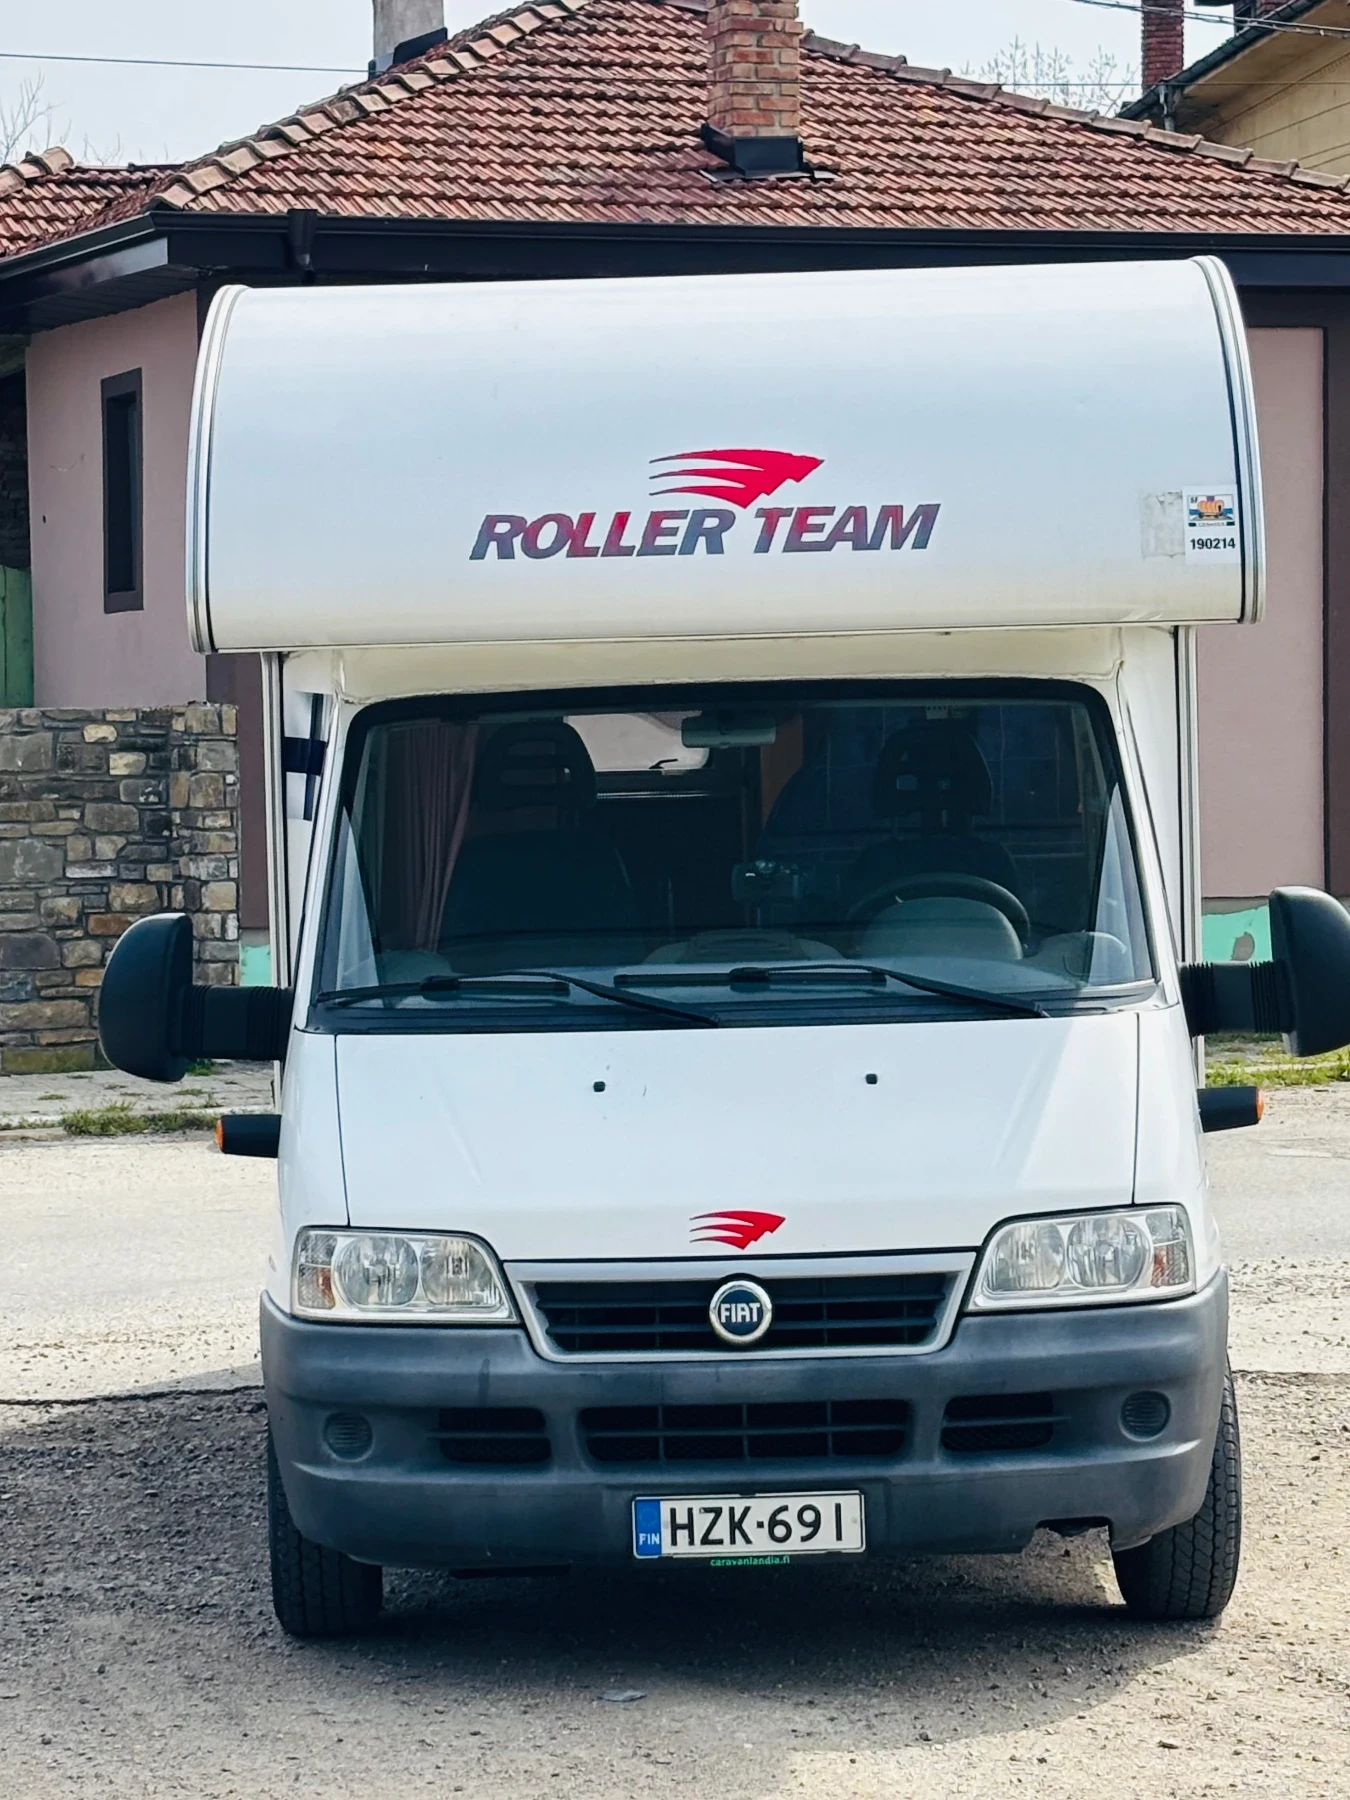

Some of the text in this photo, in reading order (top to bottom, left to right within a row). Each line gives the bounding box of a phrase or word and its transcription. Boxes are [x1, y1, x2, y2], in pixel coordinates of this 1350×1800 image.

[469, 503, 941, 560] ROLLER TEAM
[1190, 537, 1236, 550] 190214
[720, 1302, 761, 1324] FIAT
[638, 1532, 660, 1545] FIN
[710, 1555, 790, 1567] caravanlandia.fi
